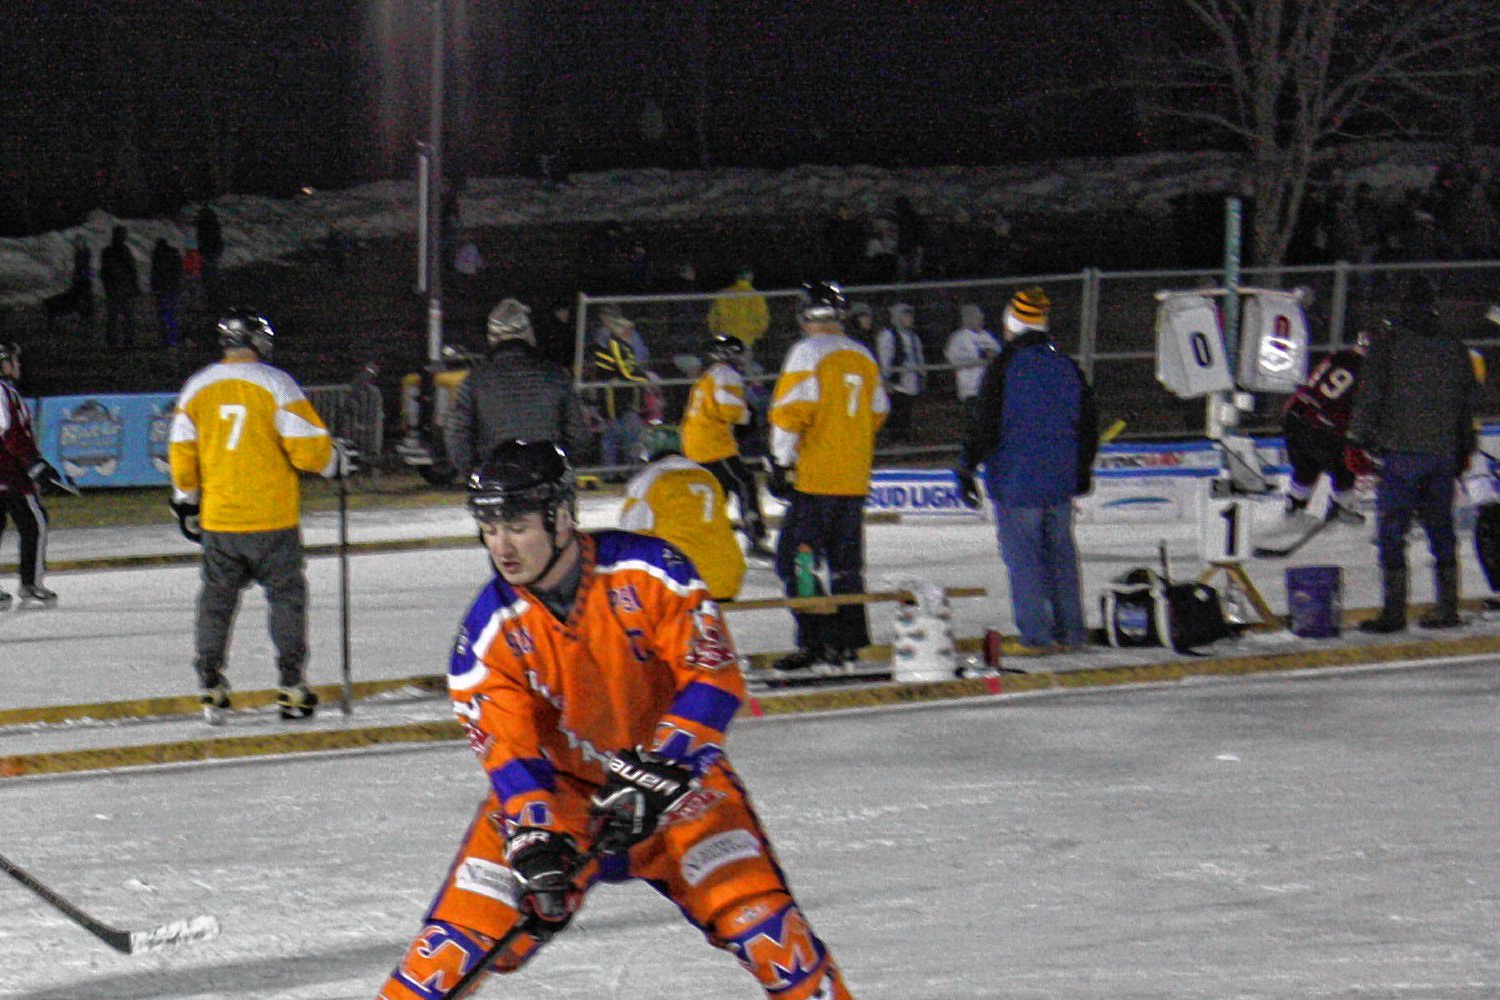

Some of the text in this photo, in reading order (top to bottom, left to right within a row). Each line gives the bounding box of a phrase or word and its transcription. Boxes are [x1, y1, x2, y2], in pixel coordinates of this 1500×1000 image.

[844, 374, 863, 416] 7
[1308, 350, 1354, 399] 19
[220, 404, 246, 450] 7
[689, 484, 714, 522] 7
[1220, 502, 1239, 556] 1
